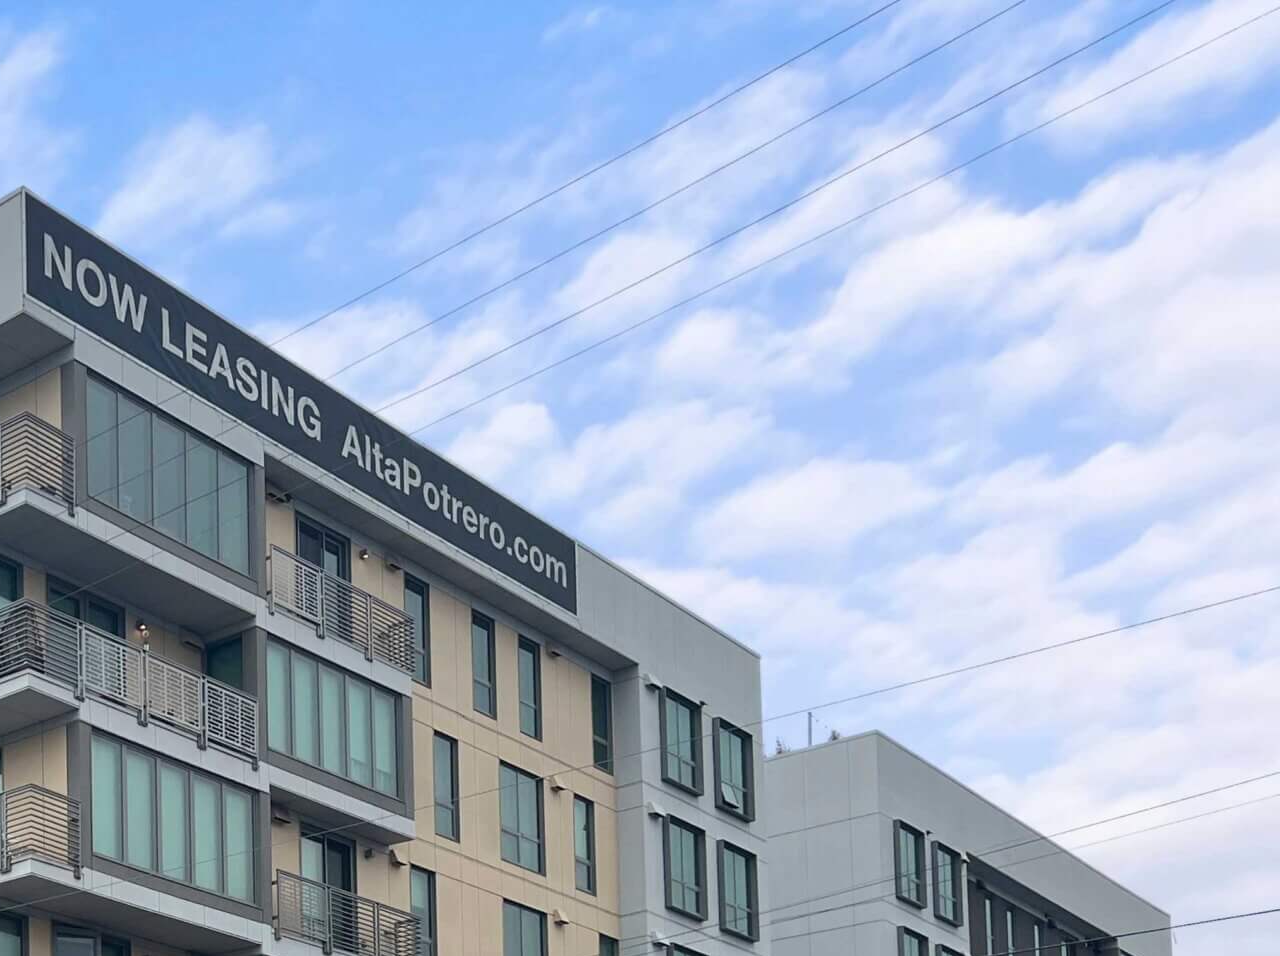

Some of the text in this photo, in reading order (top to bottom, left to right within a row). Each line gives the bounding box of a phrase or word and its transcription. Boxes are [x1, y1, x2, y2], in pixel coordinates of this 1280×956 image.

[43, 232, 567, 588] NOW LEASING AltaPotrero.com
